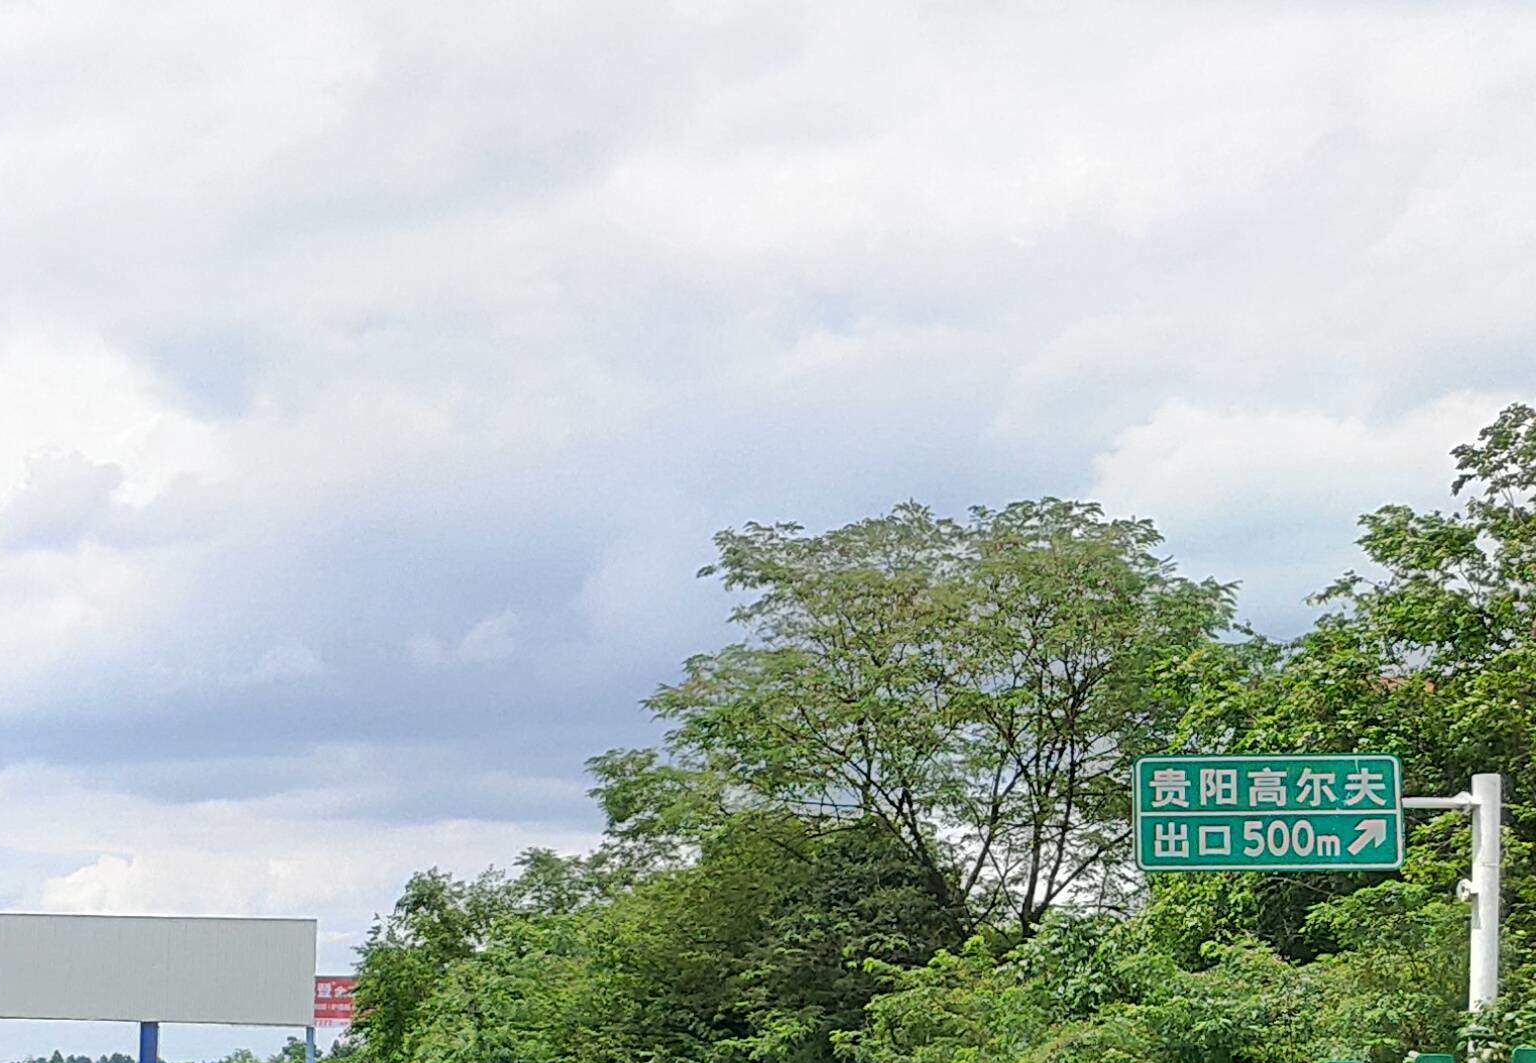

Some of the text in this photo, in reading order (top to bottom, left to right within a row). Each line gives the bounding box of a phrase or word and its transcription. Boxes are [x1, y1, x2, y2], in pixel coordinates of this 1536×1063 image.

[1148, 767, 1388, 808] 贵阳高尔夫
